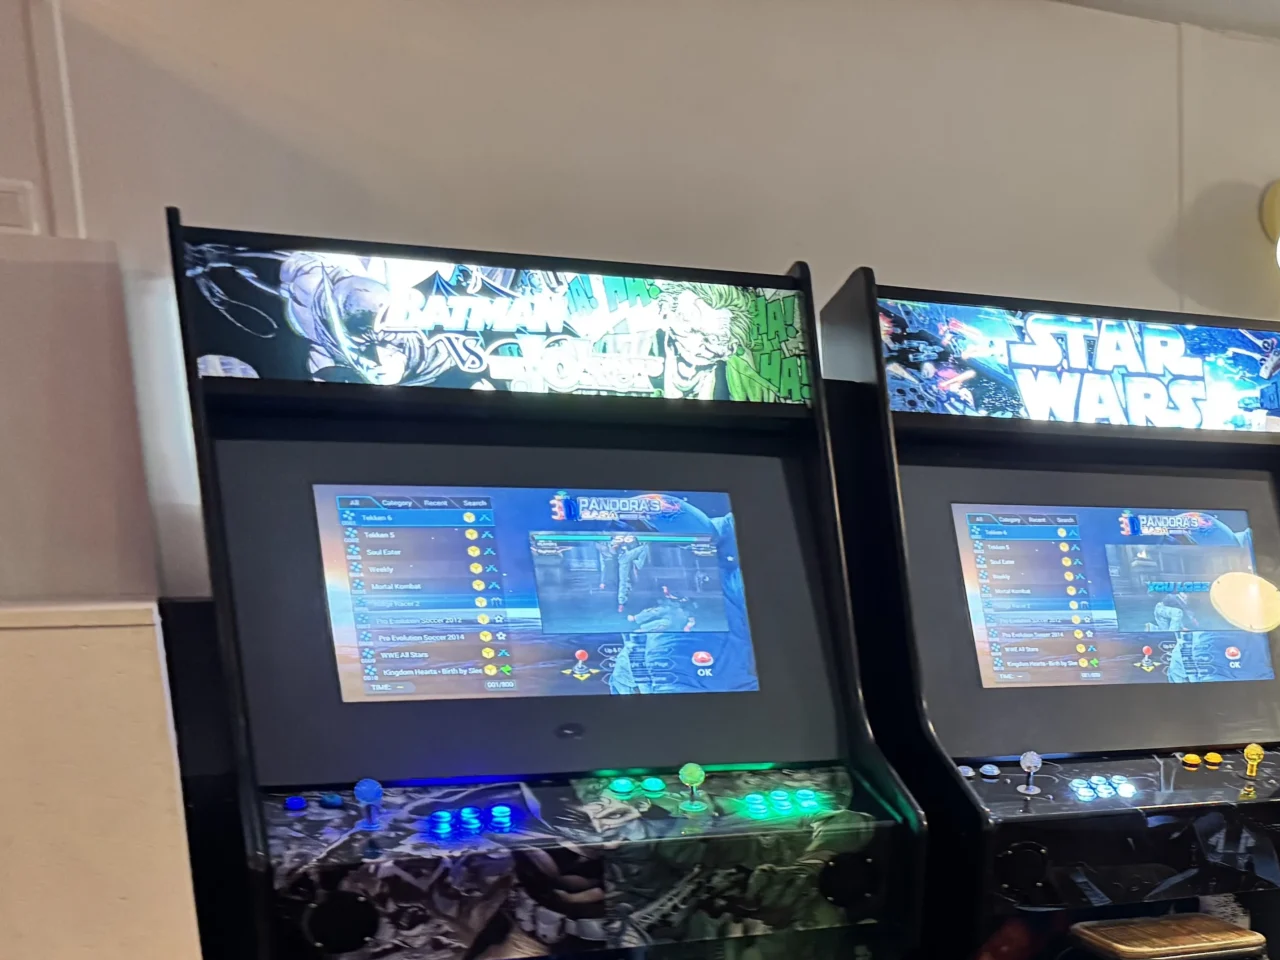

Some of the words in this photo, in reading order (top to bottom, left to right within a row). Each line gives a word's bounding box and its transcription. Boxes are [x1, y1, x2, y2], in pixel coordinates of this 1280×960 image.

[388, 291, 566, 333] BATMAN
[749, 295, 799, 342] HA!
[1008, 314, 1203, 376] STAR
[438, 334, 487, 371] VS
[760, 349, 811, 402] HA!
[1014, 368, 1206, 428] WARS
[578, 498, 661, 512] PANDORA'S
[1140, 515, 1198, 528] PANDORA'S
[614, 535, 635, 543] 56
[369, 565, 394, 574] Weekly
[1229, 661, 1241, 669] OK
[383, 669, 413, 677] Kingdom
[697, 669, 713, 677] OK
